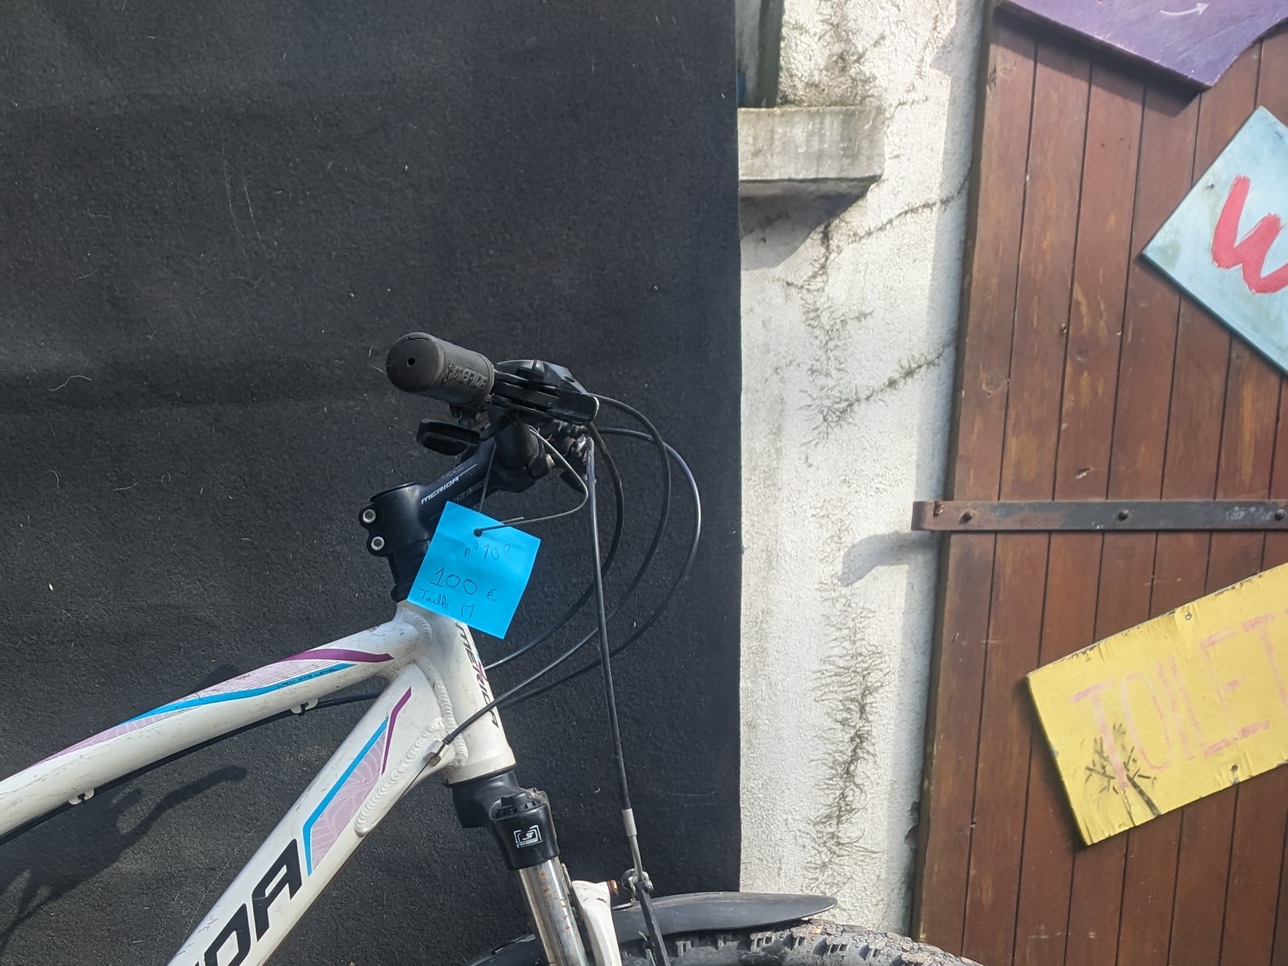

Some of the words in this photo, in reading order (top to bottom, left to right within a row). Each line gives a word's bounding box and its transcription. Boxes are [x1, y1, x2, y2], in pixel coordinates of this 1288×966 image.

[421, 476, 459, 505] MERIDA
[430, 567, 478, 595] 100
[419, 588, 449, 609] Taille
[1071, 608, 1288, 790] TOILET
